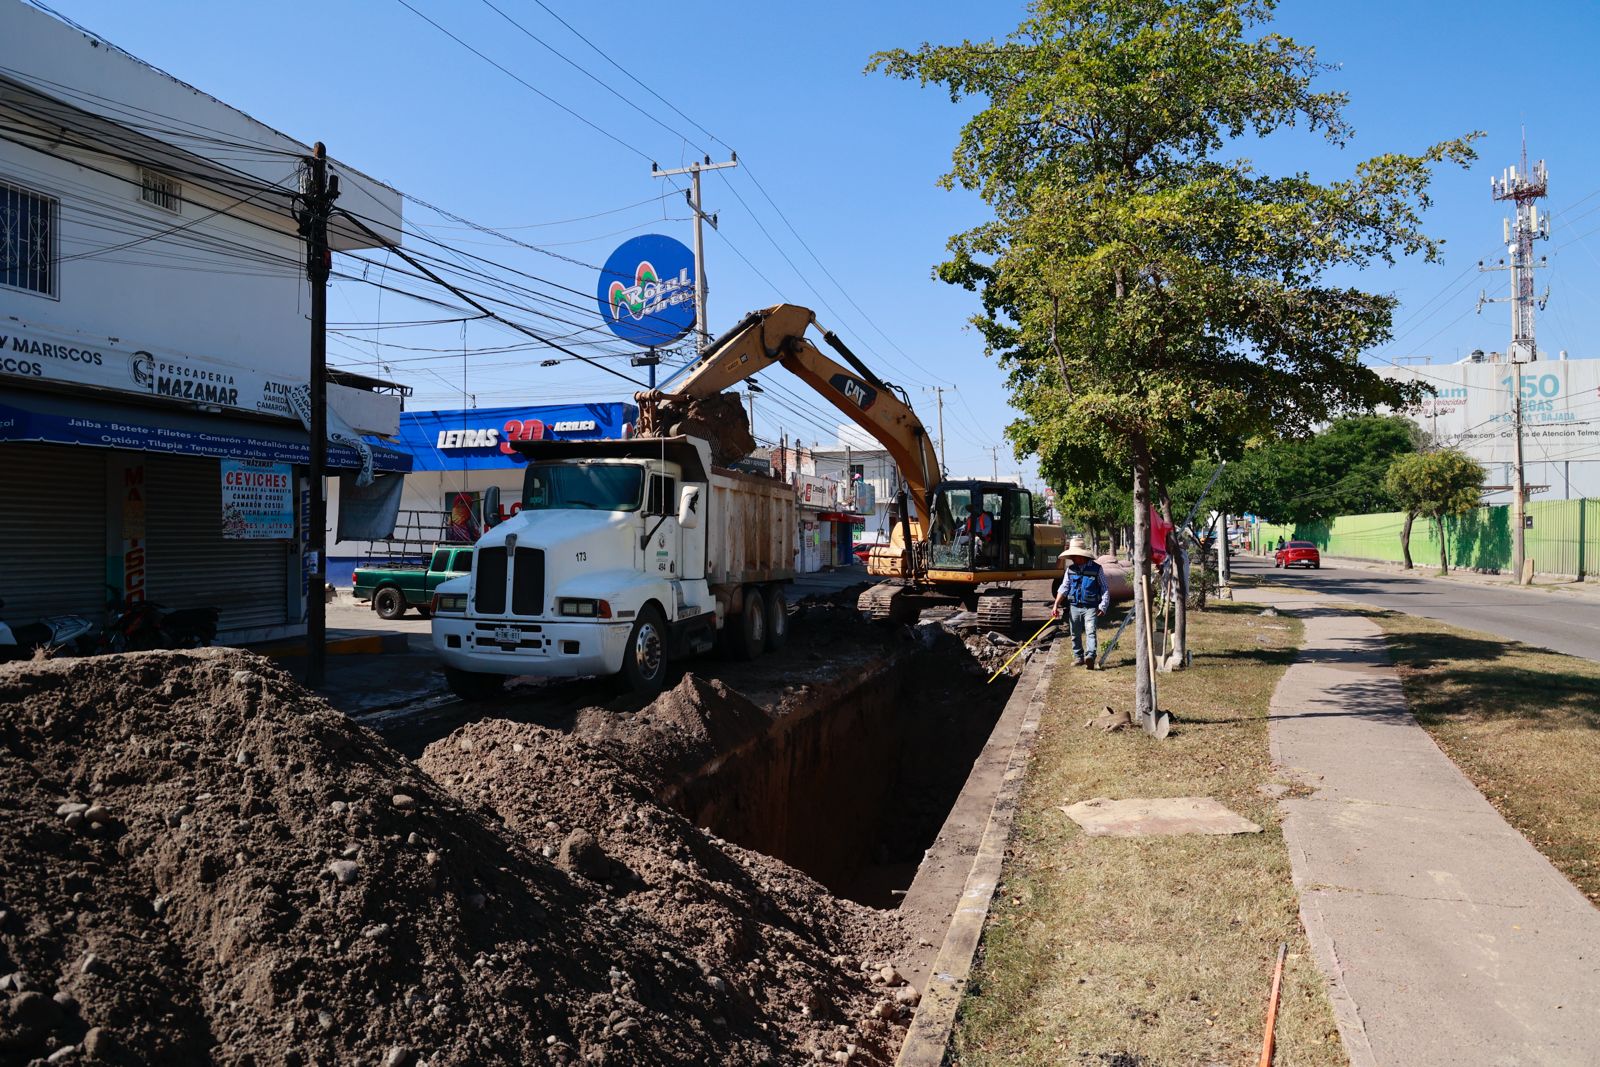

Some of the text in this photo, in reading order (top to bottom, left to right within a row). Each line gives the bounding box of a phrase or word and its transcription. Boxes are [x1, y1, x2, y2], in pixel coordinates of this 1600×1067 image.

[12, 337, 103, 366] MARISCOS
[159, 363, 234, 385] PESCADERIA
[157, 375, 239, 405] MAZAMAR
[844, 379, 866, 407] CAT
[1501, 374, 1560, 399] 150
[256, 401, 289, 413] CAMARON
[263, 393, 288, 404] VARIEDA
[291, 392, 312, 423] CARACO
[1511, 400, 1553, 412] EGAS
[1541, 412, 1575, 421] BAJADA
[67, 418, 102, 429] Jaiba
[111, 423, 149, 434] Botete
[199, 433, 241, 444] Camarón
[247, 438, 288, 450] Medallón
[436, 429, 500, 449] LETRAS
[1542, 429, 1576, 437] Atención
[100, 434, 139, 446] Ostión
[147, 439, 183, 450] Tilapia
[190, 443, 228, 454] Tenazas
[229, 447, 242, 455] de
[244, 448, 267, 458] Jaiba
[273, 451, 310, 461] Camarón
[225, 471, 287, 488] CEVICHES
[231, 501, 262, 509] CAMARÓN
[232, 493, 263, 501] CAMARÓN
[575, 551, 587, 562] 173
